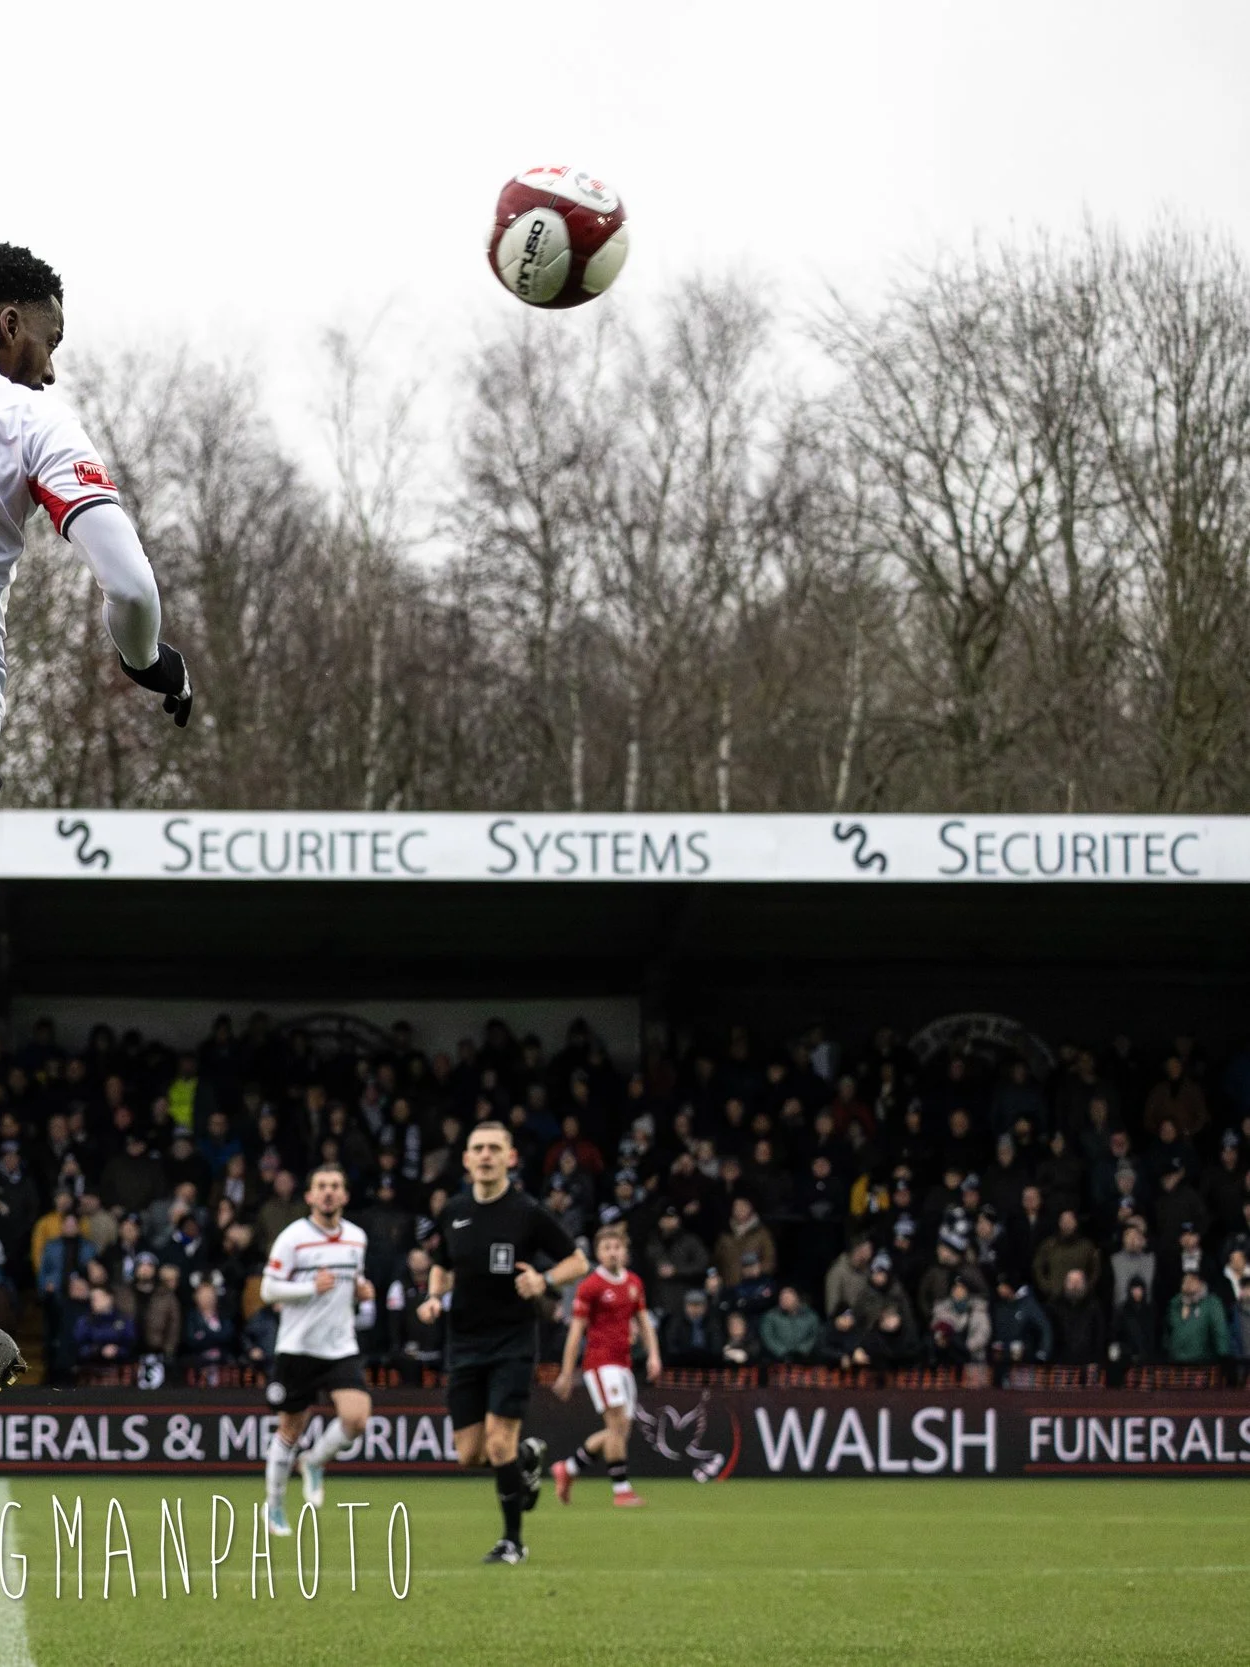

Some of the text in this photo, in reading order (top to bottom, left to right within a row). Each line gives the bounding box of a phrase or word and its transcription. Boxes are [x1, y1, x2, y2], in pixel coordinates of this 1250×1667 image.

[163, 818, 711, 876] SECURITEC SYSTEMS
[938, 820, 1200, 876] SECURITEC
[163, 1414, 207, 1462] &
[755, 1406, 997, 1473] WALSH
